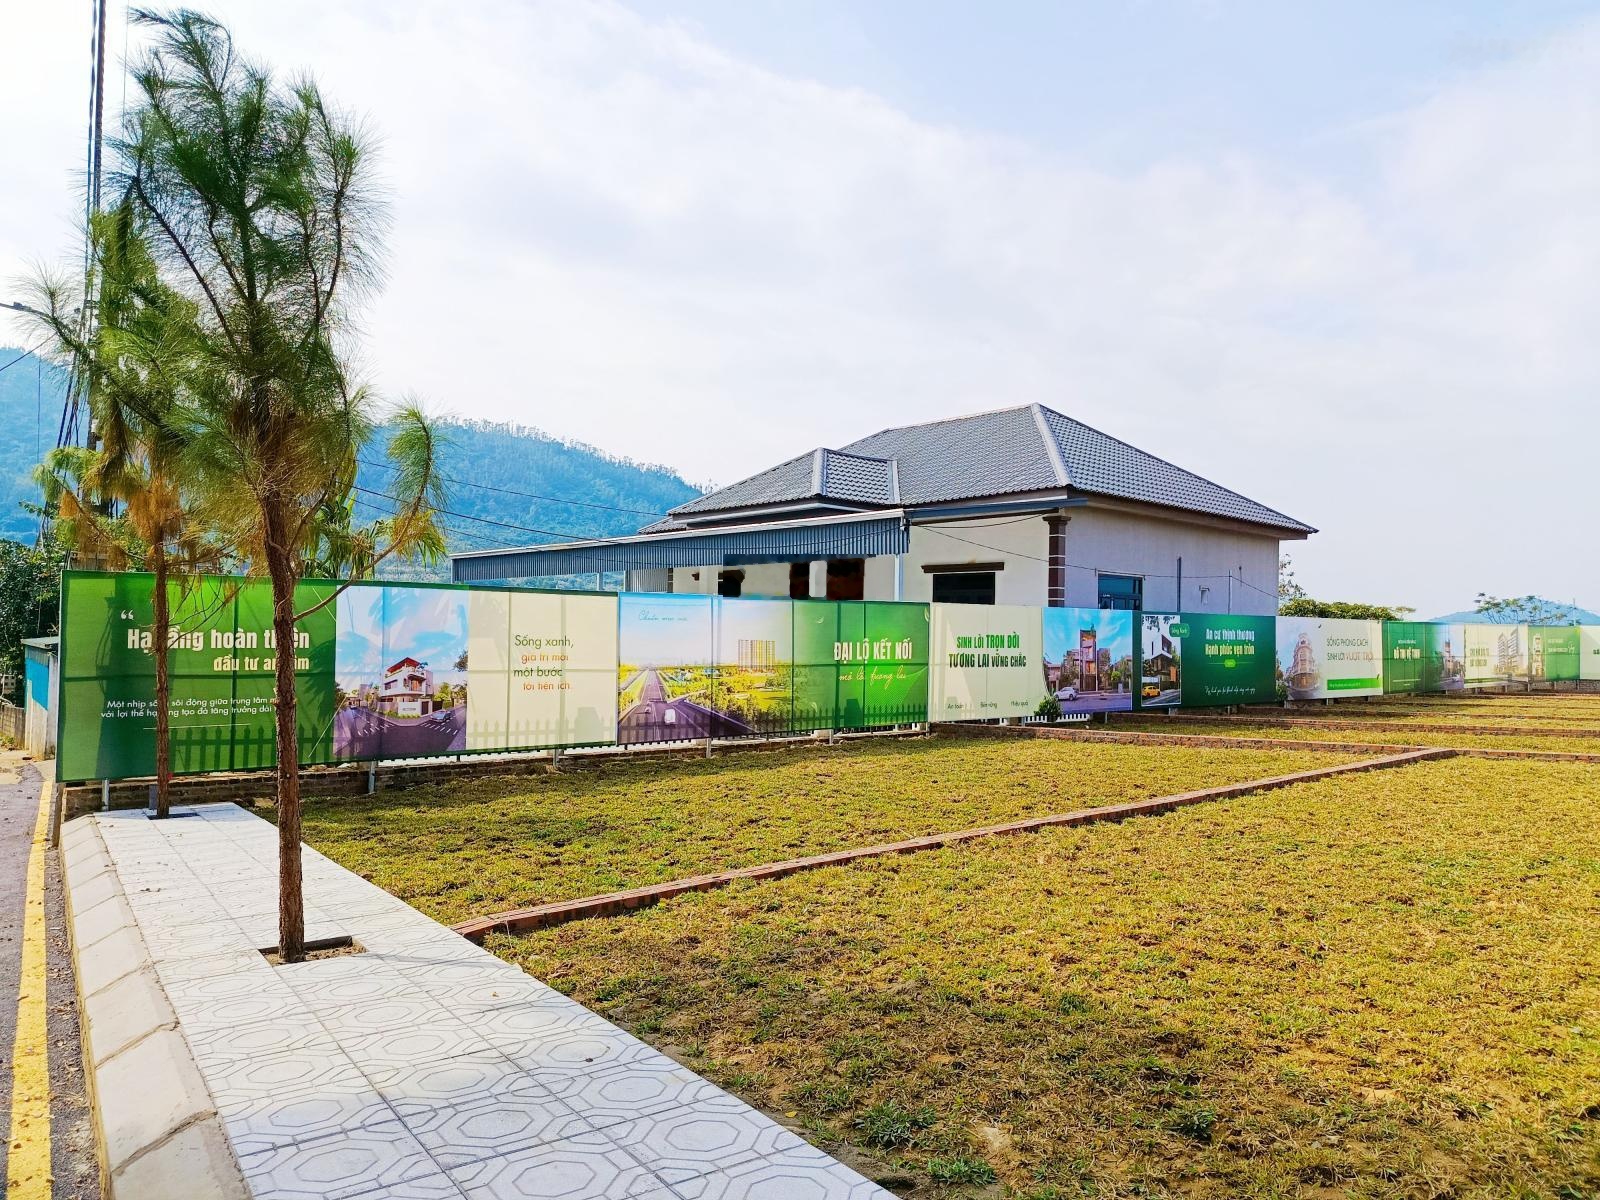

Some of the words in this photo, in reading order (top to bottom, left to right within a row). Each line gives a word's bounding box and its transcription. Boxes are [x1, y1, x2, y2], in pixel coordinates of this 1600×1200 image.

[127, 628, 153, 653] Hạ
[168, 625, 204, 652] ầng
[211, 628, 257, 649] hoàn
[514, 634, 542, 650] Sống
[545, 635, 574, 648] xanh,
[957, 636, 972, 648] SINH
[974, 633, 984, 648] LỜI
[986, 634, 1005, 651] TRỌN
[1007, 631, 1020, 649] ĐỜI
[834, 642, 853, 664] ĐẠI
[856, 638, 870, 664] LỘ
[873, 638, 892, 660] KẾT
[895, 637, 913, 660] NỐI
[214, 655, 239, 671] đầu
[245, 656, 259, 671] tư
[949, 653, 975, 668] TƯƠNG
[978, 653, 990, 668] LAI
[991, 650, 1009, 667] VỮNG
[1010, 651, 1027, 667] CHẮC
[513, 667, 534, 678] một
[536, 665, 563, 677] bước
[107, 700, 125, 709] Một
[127, 699, 147, 709] nhịp
[186, 698, 207, 708] động
[231, 697, 250, 706] trung
[101, 710, 114, 718] với
[117, 709, 128, 719] lợi
[131, 708, 144, 717] thế
[182, 708, 195, 716] tạo
[197, 707, 208, 715] đà
[259, 704, 272, 713] dài
